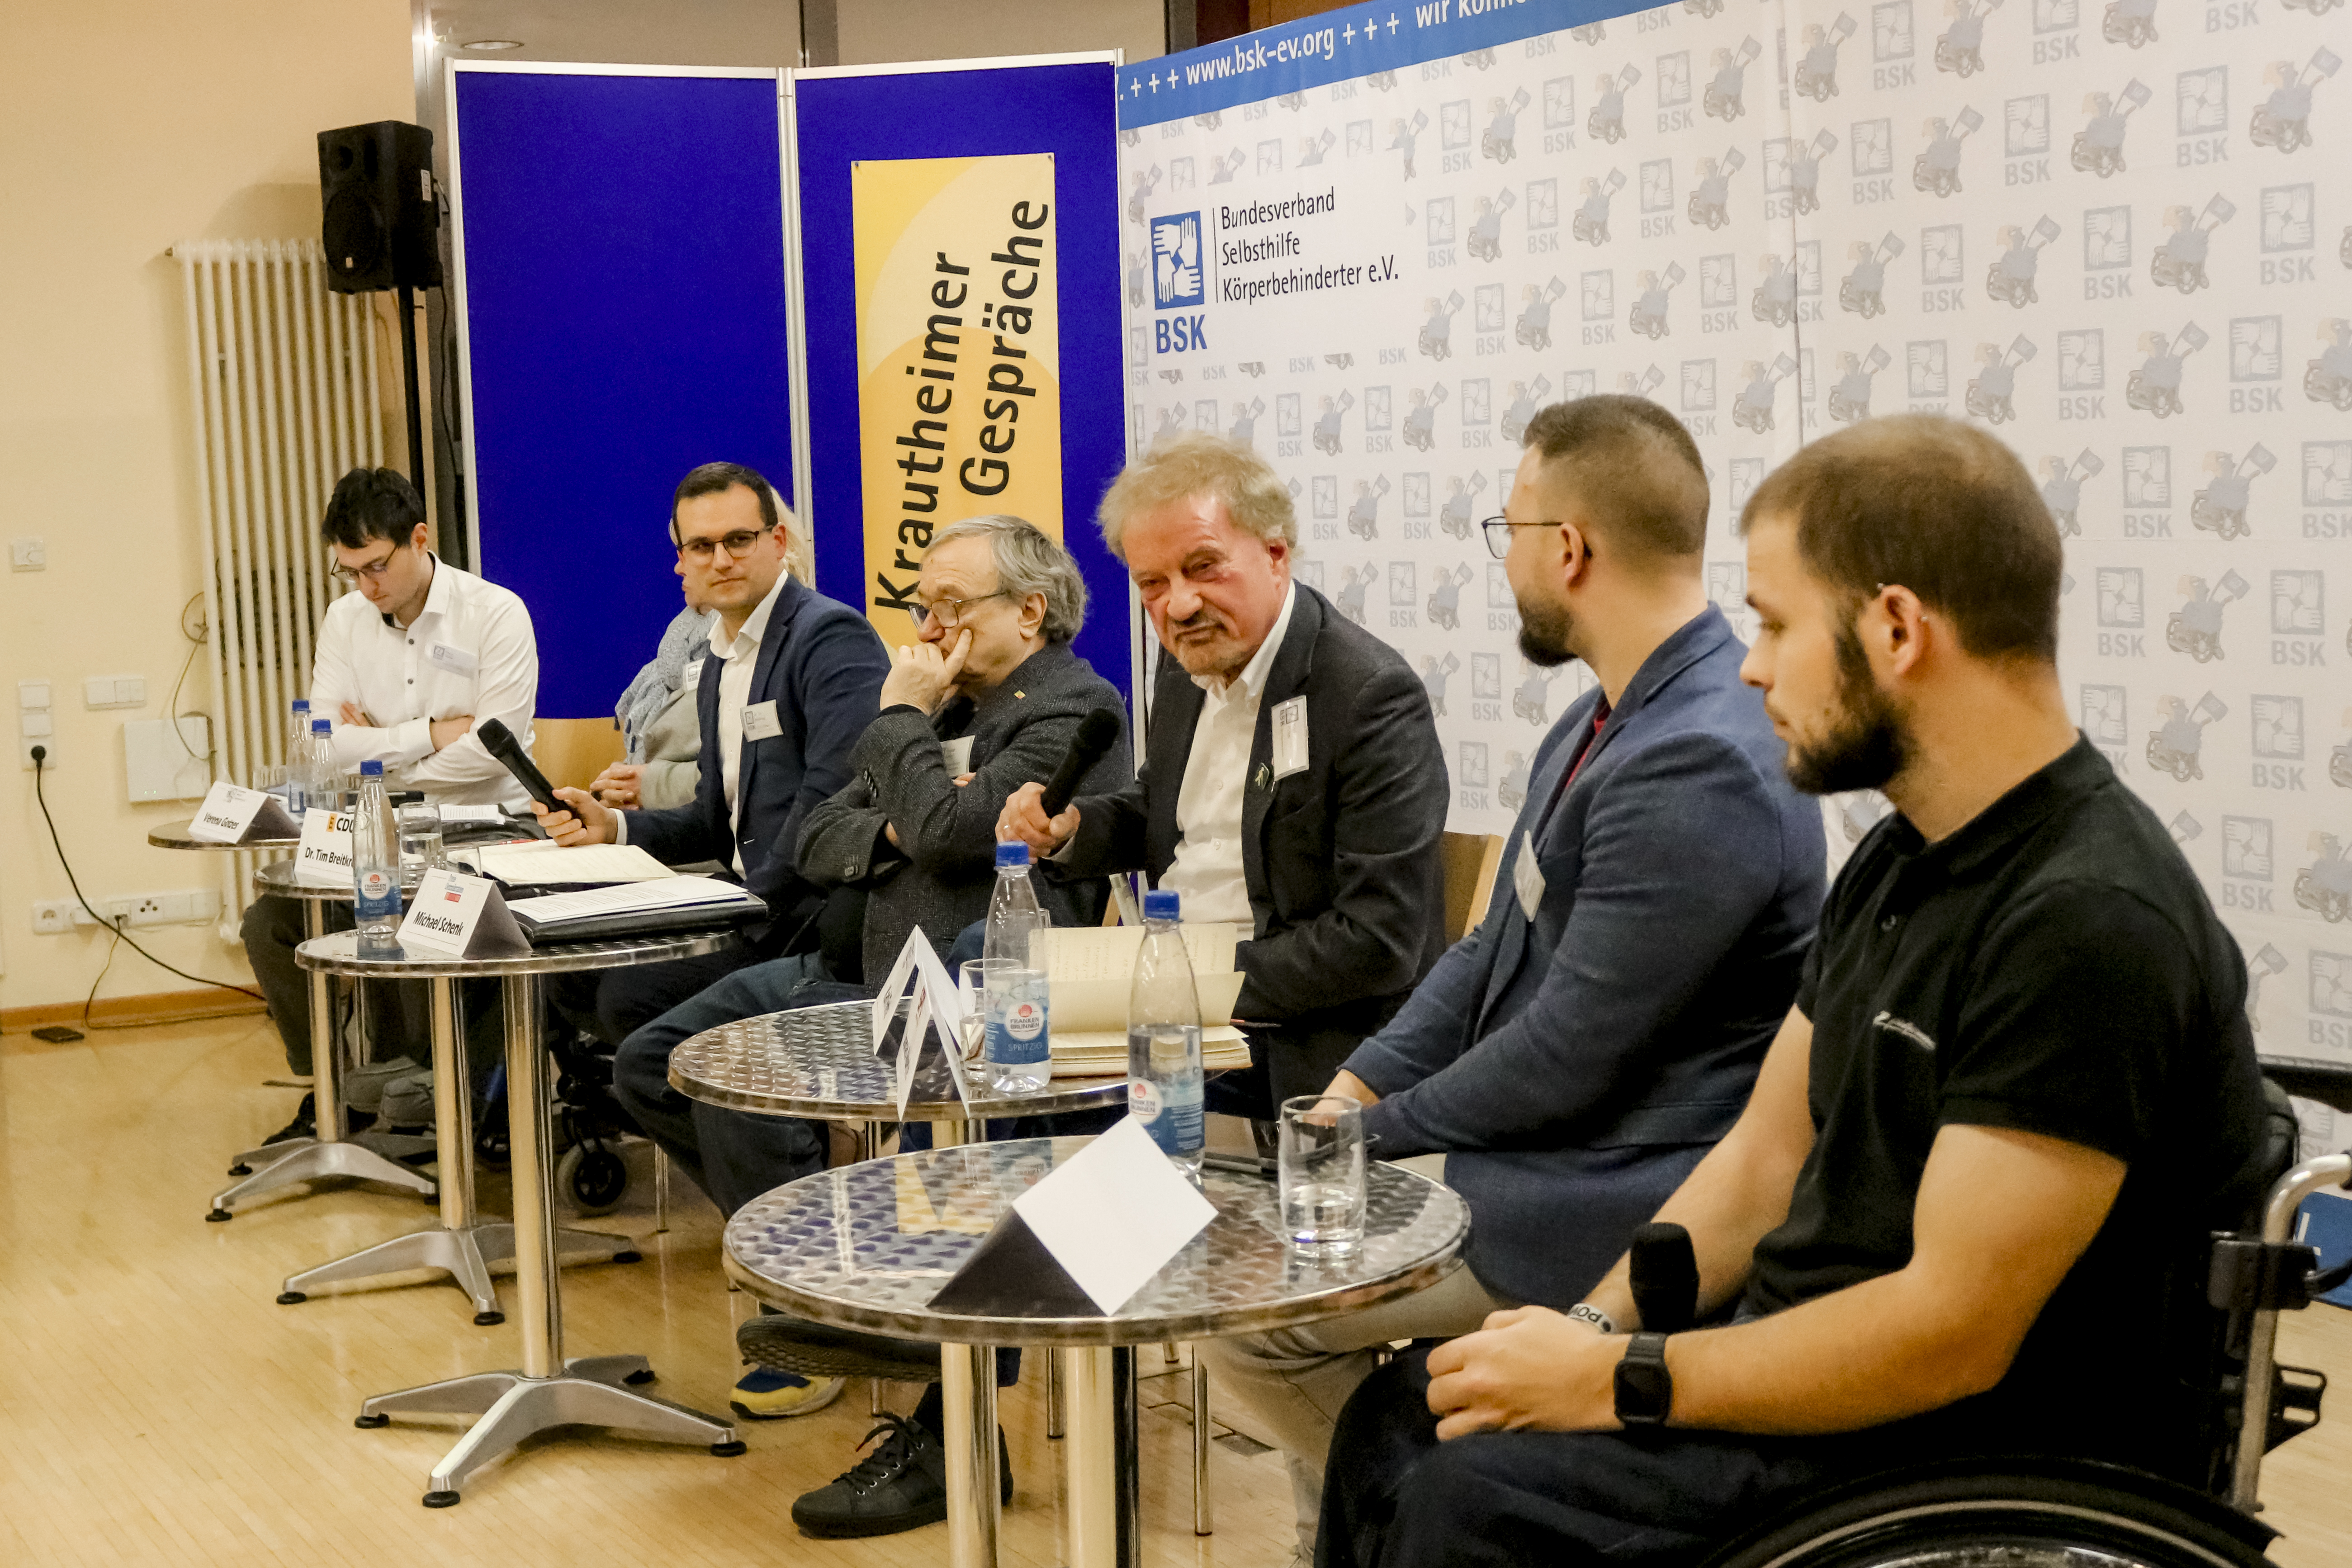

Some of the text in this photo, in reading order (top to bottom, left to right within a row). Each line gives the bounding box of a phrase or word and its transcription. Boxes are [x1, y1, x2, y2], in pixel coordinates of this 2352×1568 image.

[1637, 8, 1671, 33] BSK
[2205, 6, 2259, 33] BSK
[1186, 27, 1334, 85] www.bsk-ev.org
[1525, 35, 1556, 59] BSK
[2033, 34, 2080, 65] BSK
[1422, 58, 1452, 82] BSK
[1874, 62, 1916, 90] BSK
[1162, 119, 1184, 139] BSK
[1657, 108, 1694, 133] BSK
[1544, 131, 1576, 154] BSK
[2177, 137, 2229, 168] BSK
[1442, 151, 1472, 174] BSK
[2005, 159, 2051, 186] BSK
[1853, 179, 1895, 204] BSK
[1222, 186, 1334, 229] Bundesverband
[1765, 198, 1792, 220] BS
[1641, 215, 1675, 239] BSK
[1222, 232, 1300, 266] Selbsthilfe
[1528, 232, 1559, 254] BSK
[1428, 248, 1457, 269] BSK
[2260, 256, 2315, 285] BSK
[1223, 255, 1398, 305] Körperbehinderter e.V.
[2084, 274, 2133, 300] BSK
[1799, 301, 1824, 323] SK
[1922, 288, 1965, 313] BSK
[1155, 314, 1207, 354] BSK
[1701, 311, 1739, 333] BSK
[1476, 336, 1506, 356] BSK
[1582, 324, 1615, 345] BSK
[960, 201, 1048, 496] Gespräche
[1379, 348, 1407, 365] BSK
[1202, 365, 1226, 380] BSK
[1289, 357, 1315, 374] BSK
[2059, 396, 2106, 420] BSK
[2229, 387, 2284, 413] BSK
[875, 251, 970, 610] Krautheimer
[1462, 430, 1492, 448] BSK
[1278, 440, 1302, 457] BSK
[1366, 435, 1393, 453] BSK
[1313, 523, 1339, 540] BSK
[1404, 522, 1432, 540] BSK
[2124, 514, 2172, 538] BSK
[1390, 610, 1417, 628] BSK
[2098, 633, 2146, 658] BSK
[2272, 640, 2326, 666] BSK
[1472, 703, 1502, 721] BSK
[2252, 763, 2306, 791] BSK
[1460, 790, 1489, 810] BSK
[305, 847, 354, 867] Dr. Tim Breitkr
[2222, 882, 2275, 913] BSK
[413, 911, 464, 936] Michael Schenk
